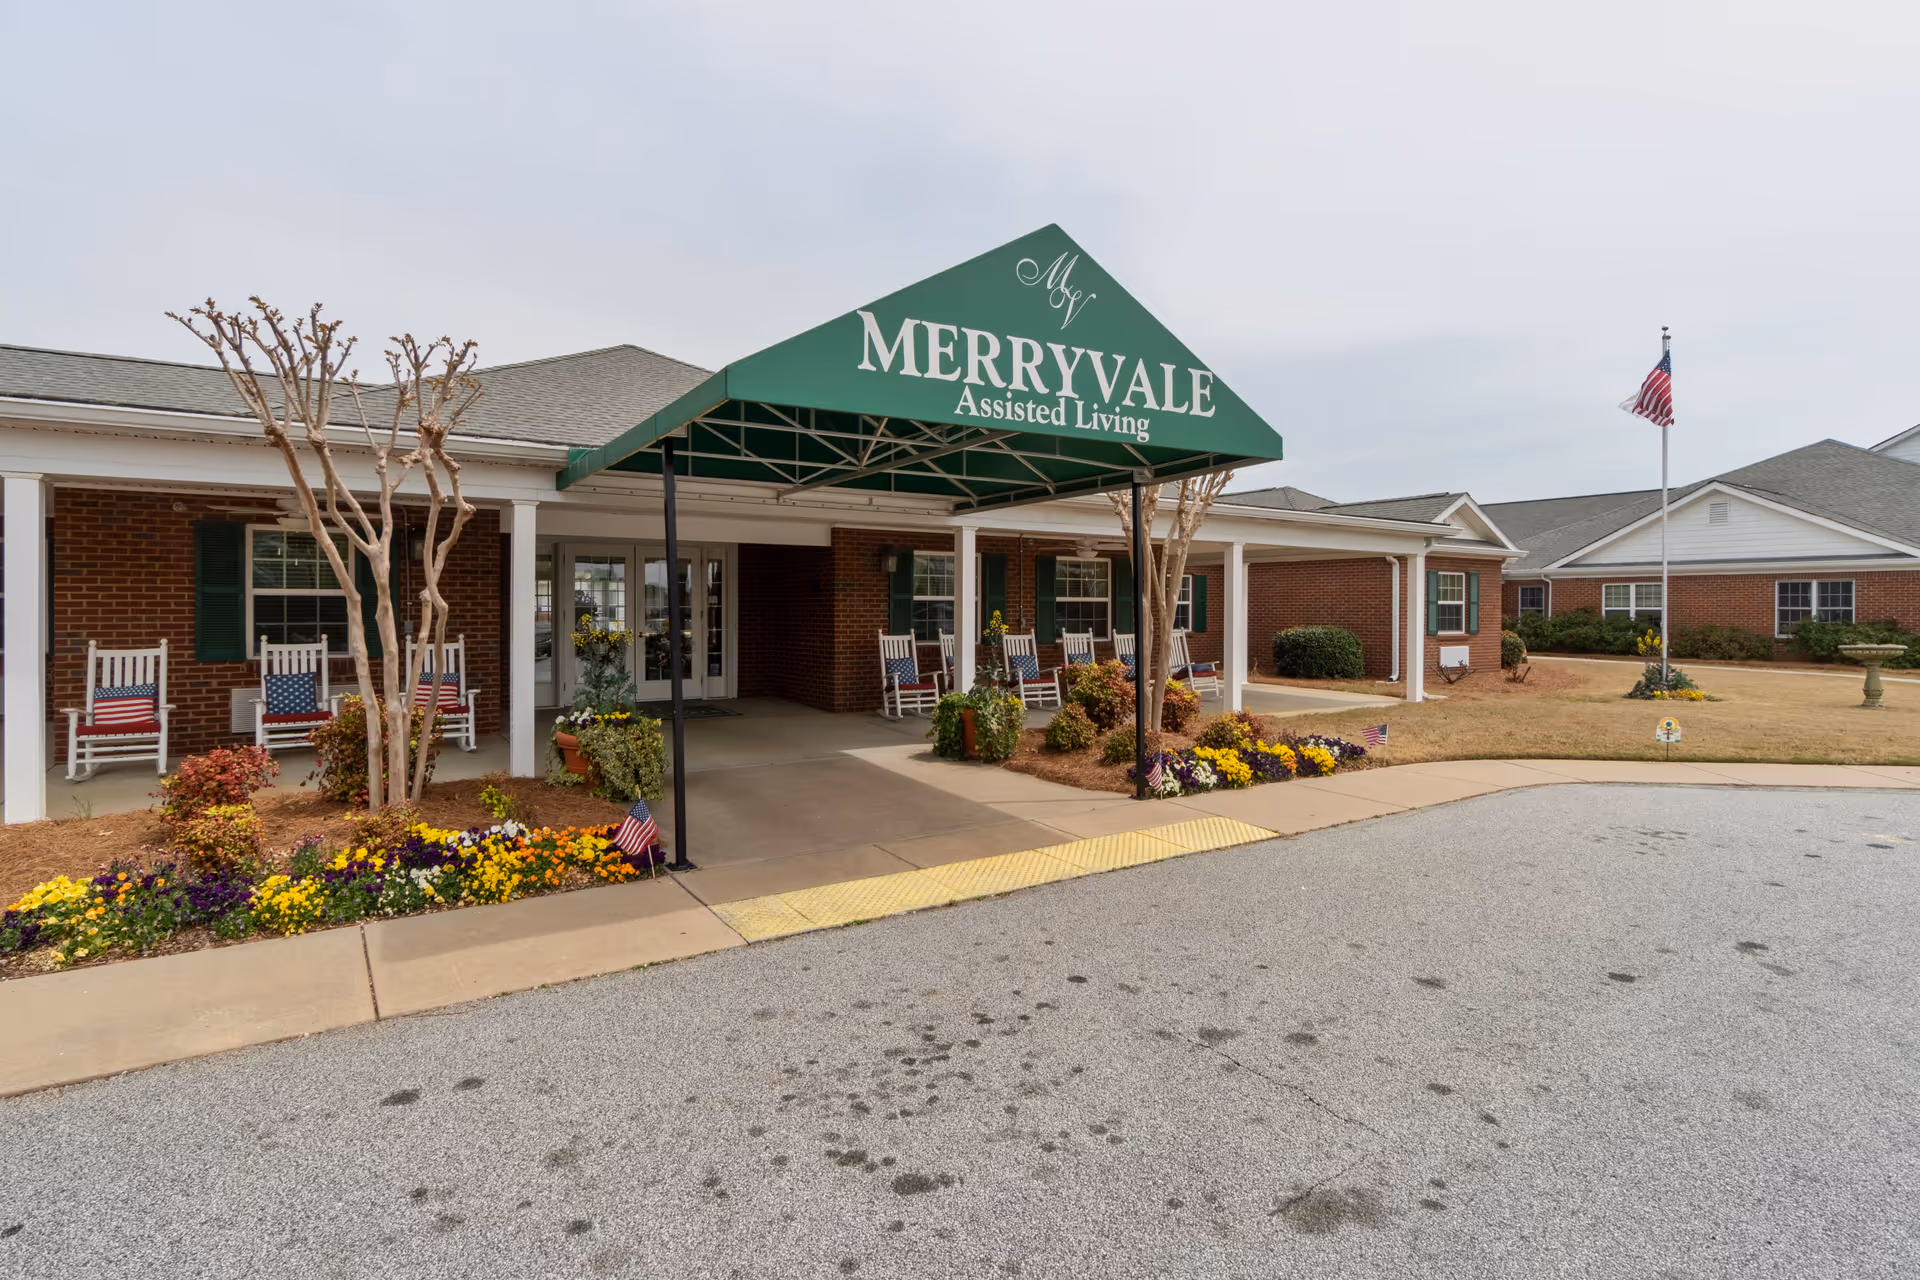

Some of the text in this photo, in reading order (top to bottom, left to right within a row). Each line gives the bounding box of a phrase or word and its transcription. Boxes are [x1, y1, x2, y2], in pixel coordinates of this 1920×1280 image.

[856, 309, 1217, 418] MERRYVALE
[953, 385, 1151, 443] Assisted Living
